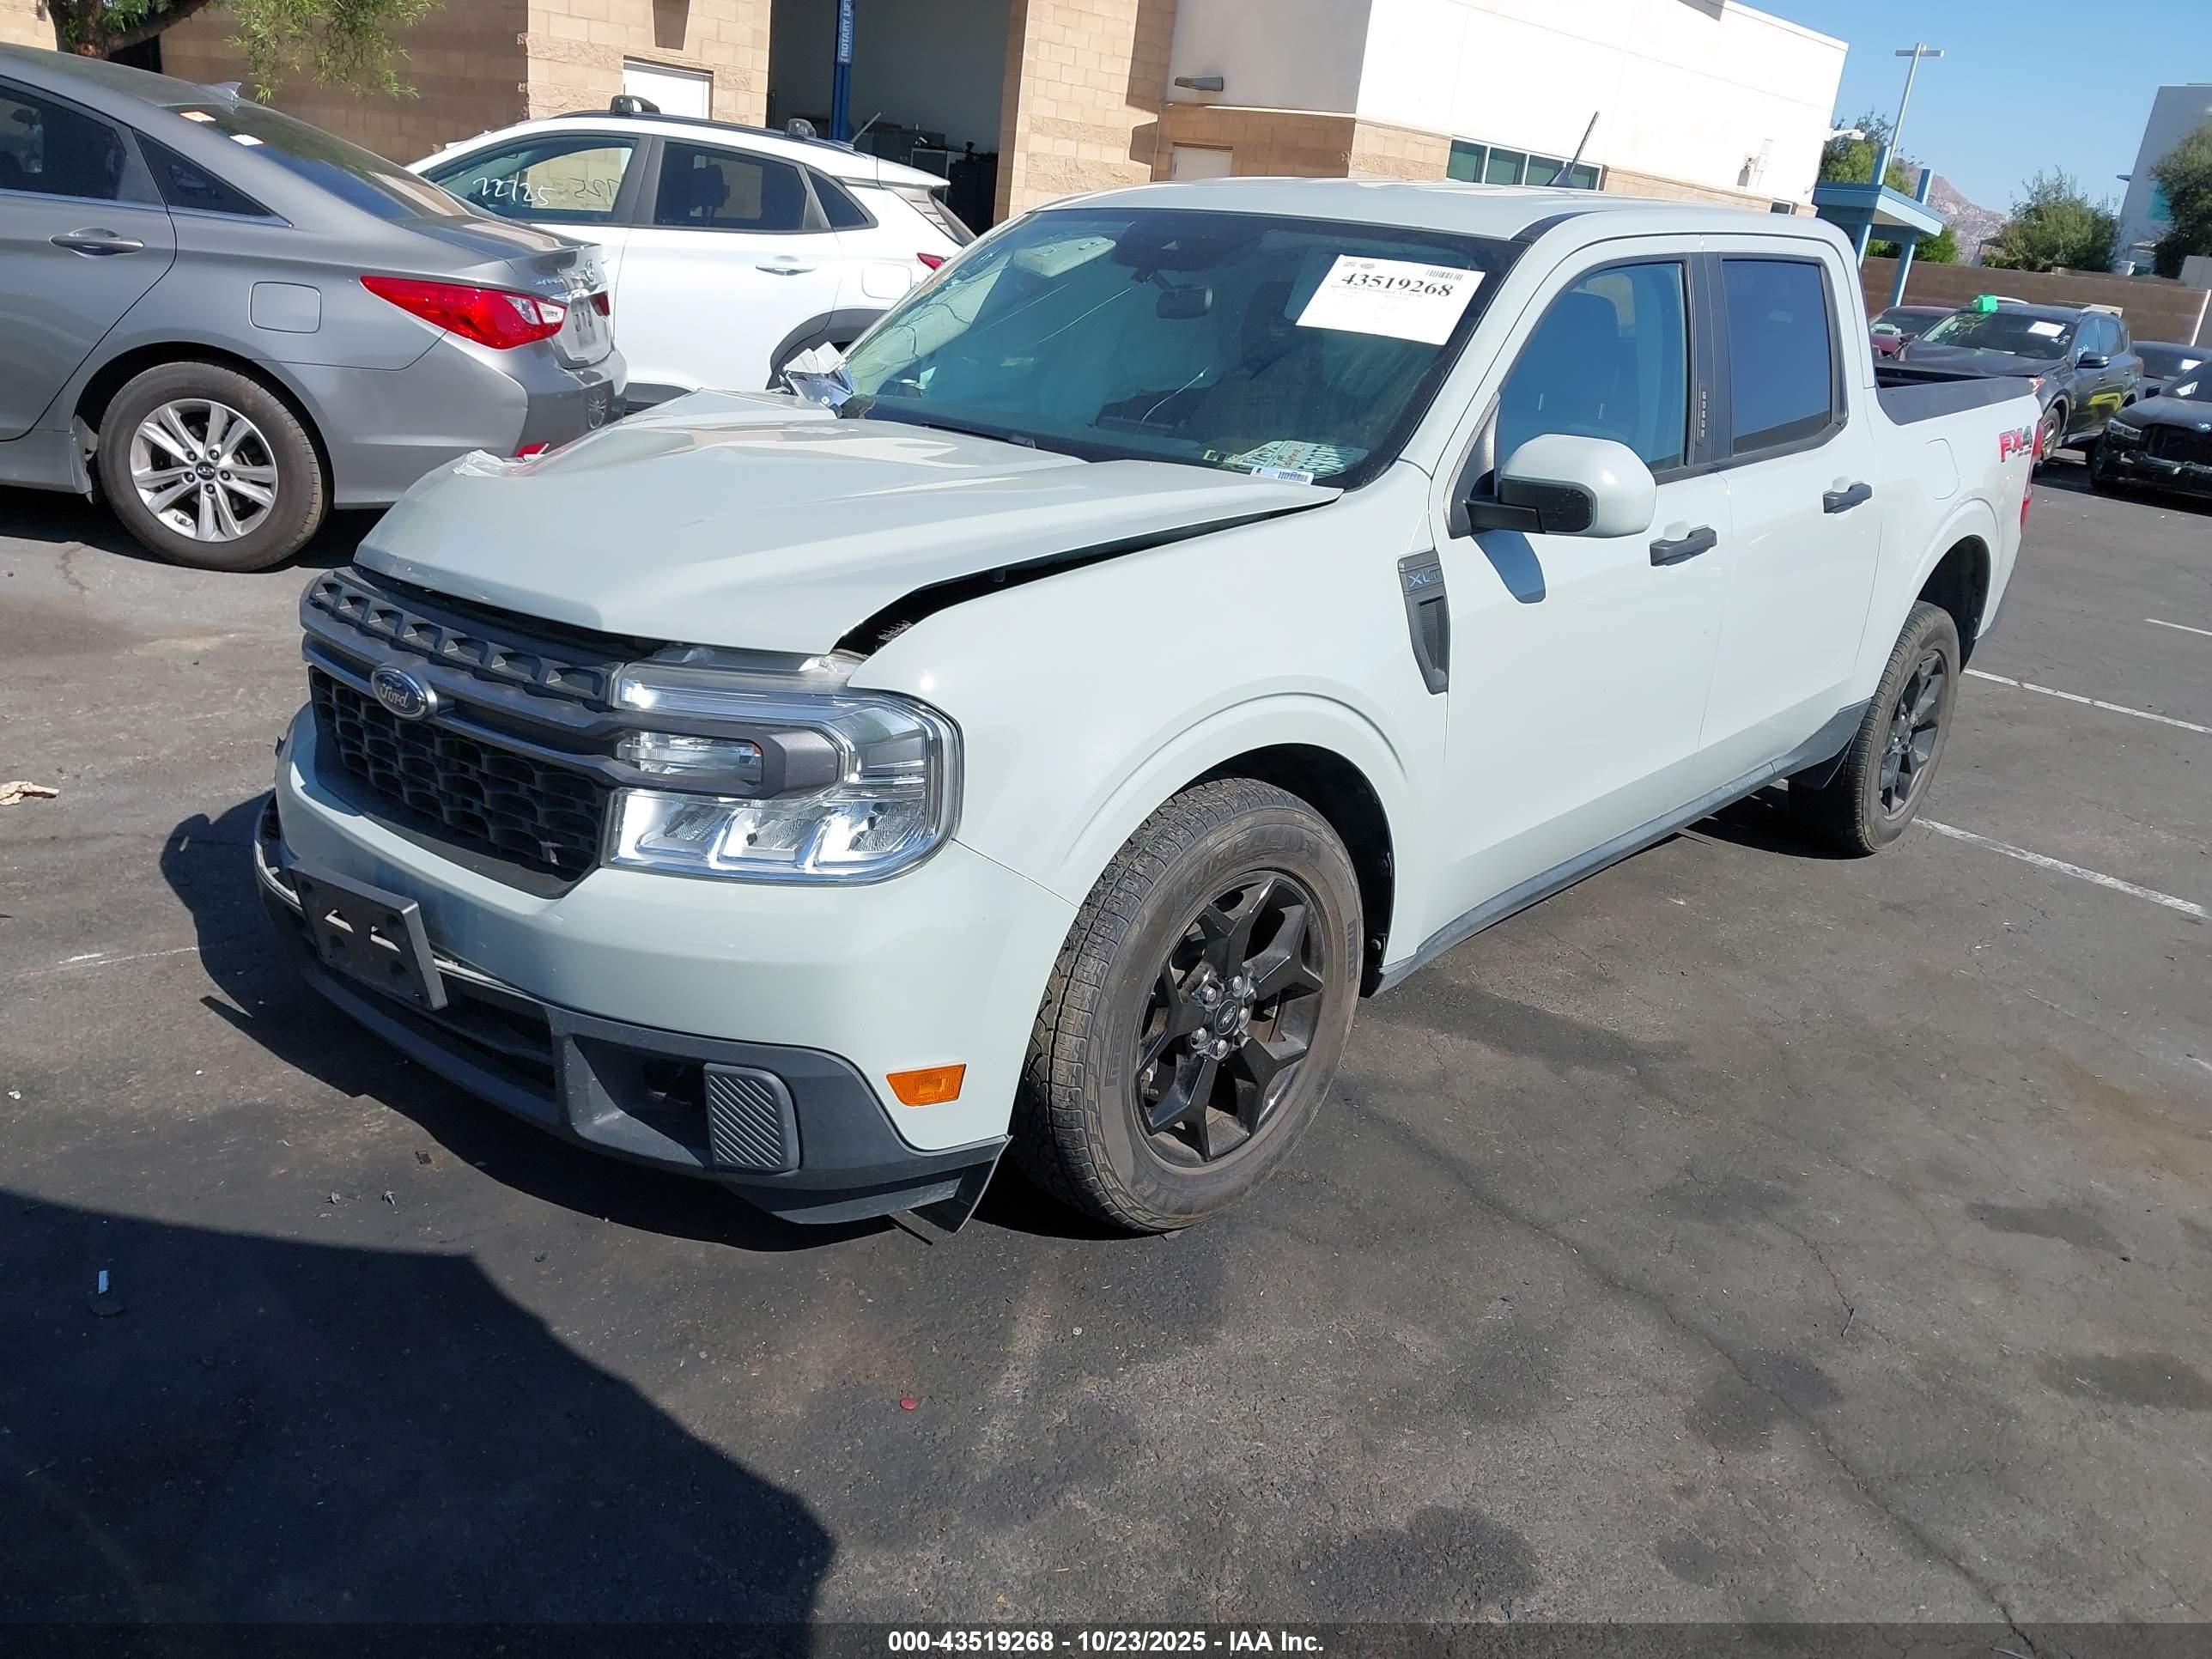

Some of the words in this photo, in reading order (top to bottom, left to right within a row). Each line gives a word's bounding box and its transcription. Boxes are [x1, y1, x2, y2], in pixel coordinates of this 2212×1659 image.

[842, 0, 851, 16] LIF
[841, 19, 850, 57] ROTARY
[1341, 273, 1453, 296] 43519268
[1999, 426, 2033, 462] FX4
[1408, 569, 1437, 587] XLT
[380, 684, 410, 708] Ford
